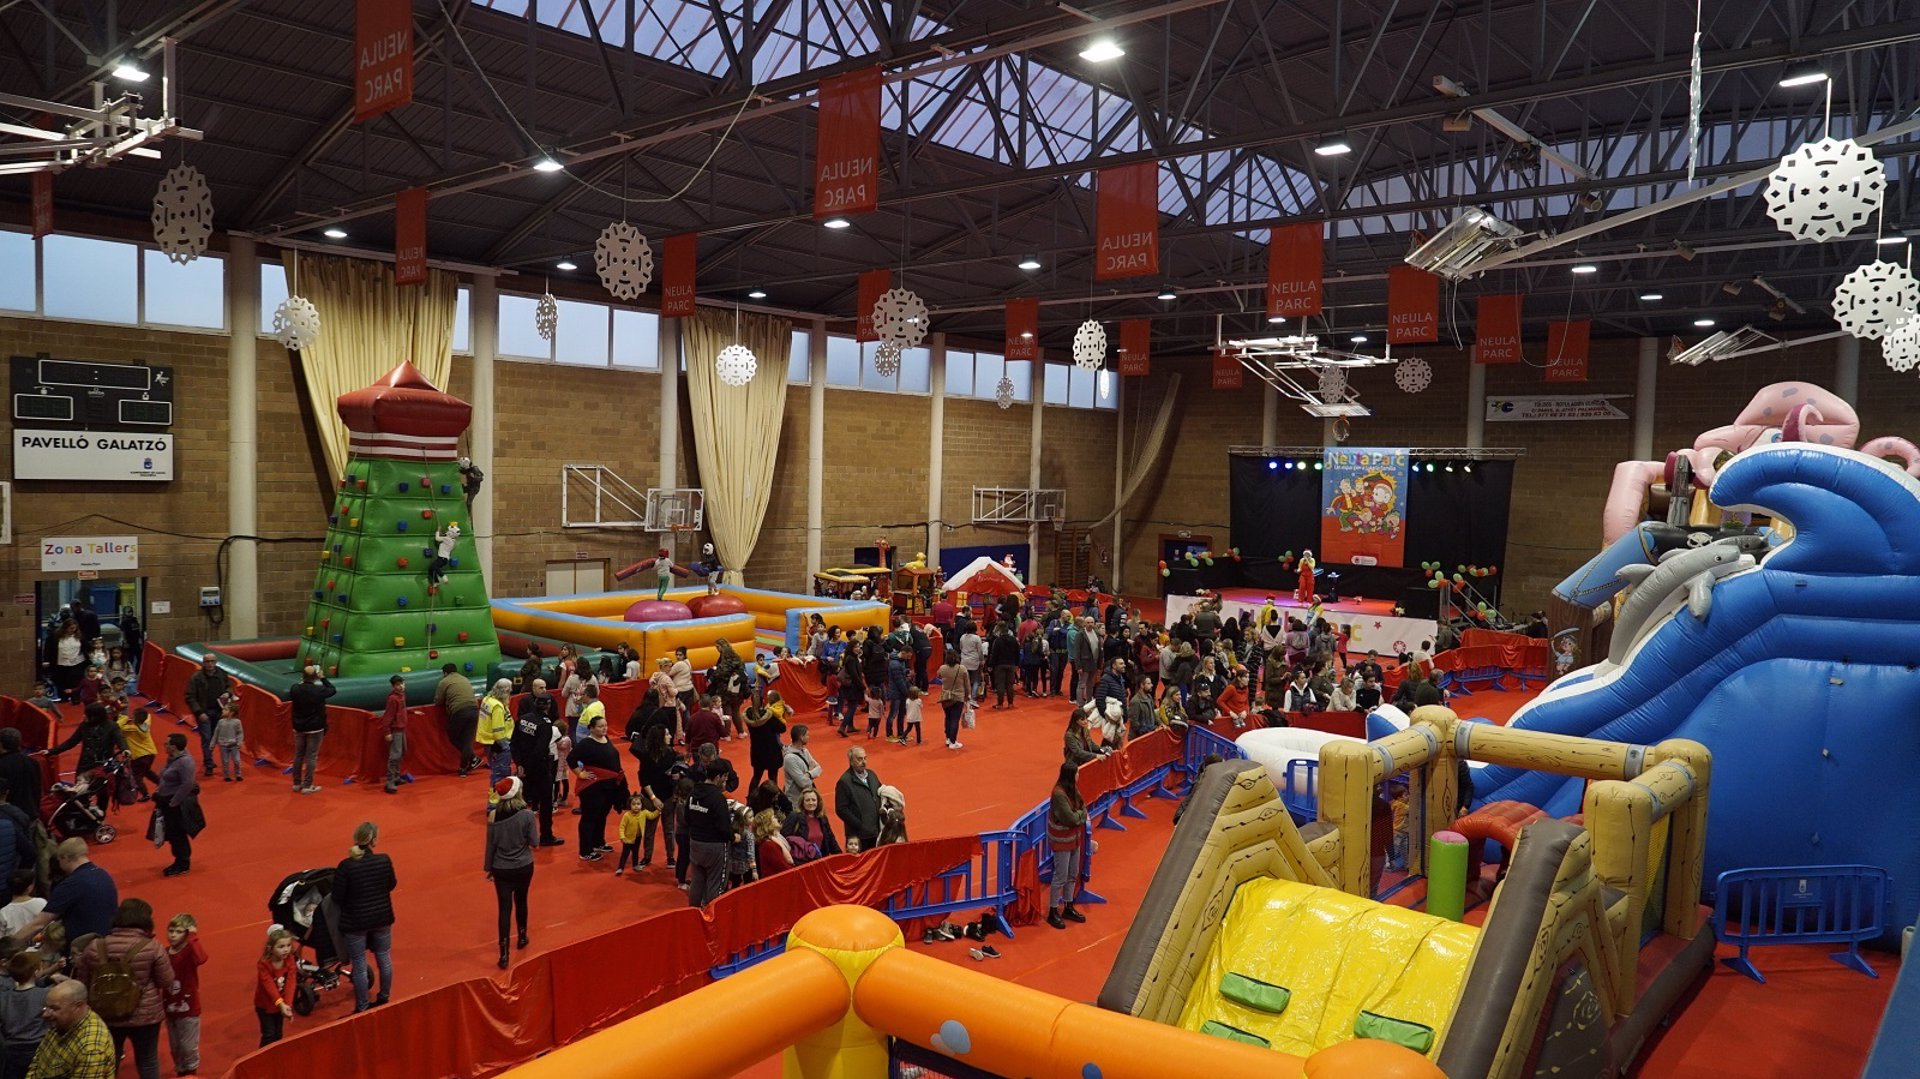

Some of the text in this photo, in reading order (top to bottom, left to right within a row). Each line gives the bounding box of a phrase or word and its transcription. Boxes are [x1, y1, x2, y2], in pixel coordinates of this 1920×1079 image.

[665, 285, 692, 297] NEULA
[1271, 280, 1317, 295] NEULA
[667, 300, 690, 311] PARC
[1276, 297, 1312, 311] PARC
[1392, 312, 1433, 325] NEULA
[1396, 326, 1429, 338] PARC
[1480, 336, 1517, 347] NEULA
[1010, 347, 1033, 358] PARC
[1121, 352, 1147, 361] NEULA
[1482, 349, 1513, 359] PARC
[1123, 363, 1144, 372] PARC
[1550, 358, 1584, 367] NEULA
[1552, 368, 1580, 377] PARC
[22, 435, 167, 451] PAVELLÓ GALATZÓ
[1371, 451, 1405, 467] Parc
[45, 542, 137, 554] Zona Tallers
